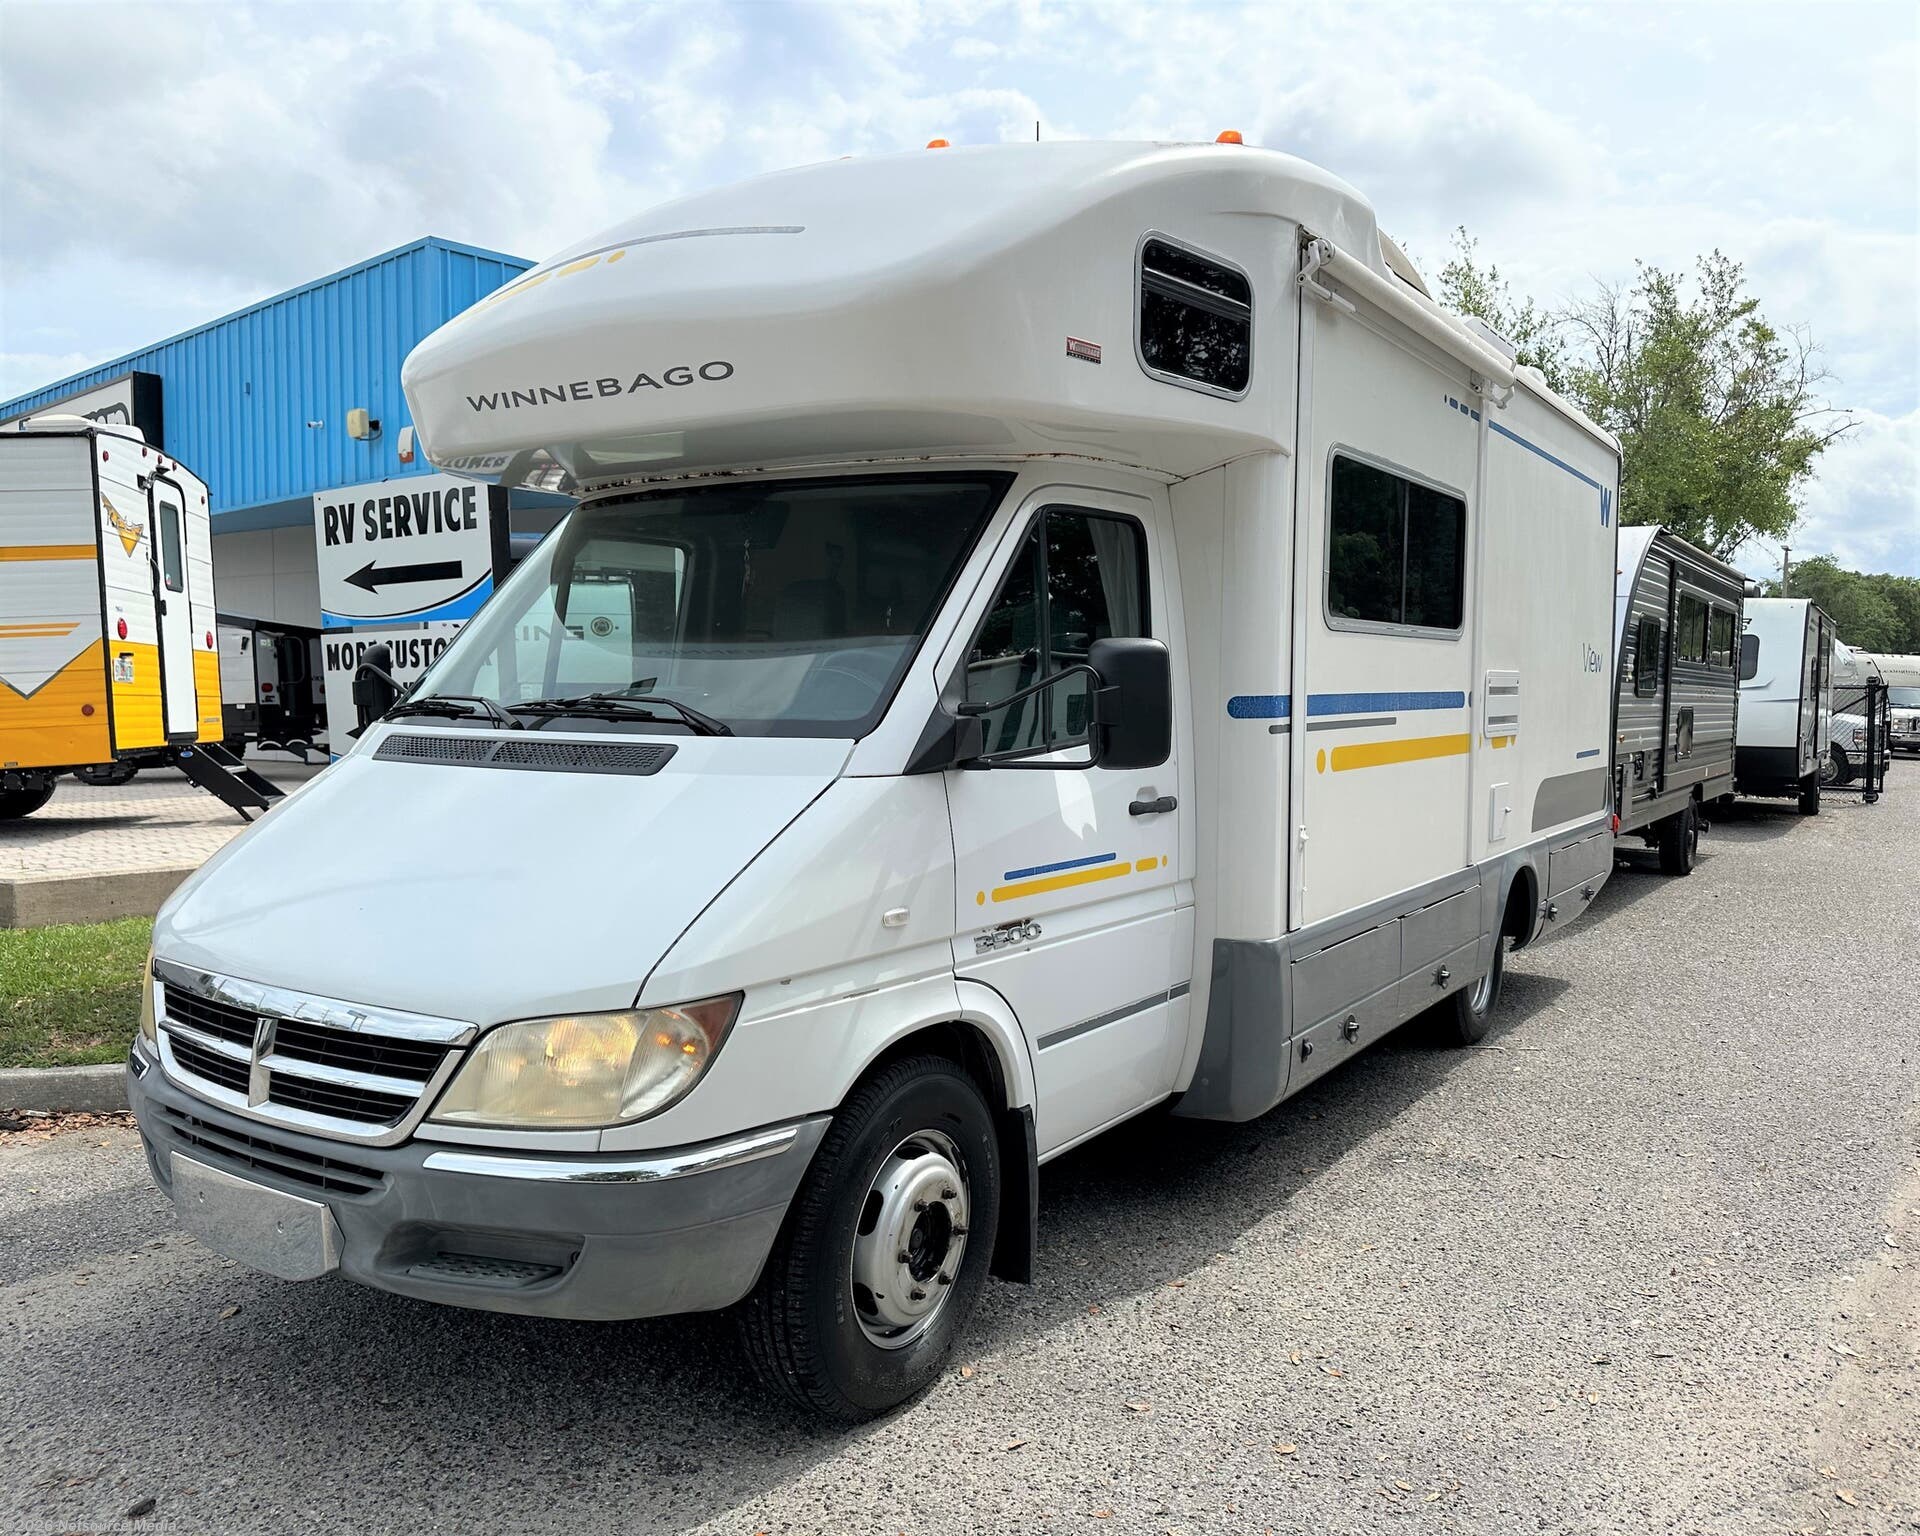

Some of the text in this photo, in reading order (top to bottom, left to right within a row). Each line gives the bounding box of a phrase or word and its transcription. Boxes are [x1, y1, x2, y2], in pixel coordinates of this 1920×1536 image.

[466, 361, 734, 412] WINNEBAGO
[323, 486, 478, 547] RV SERVICE
[1582, 643, 1603, 673] View
